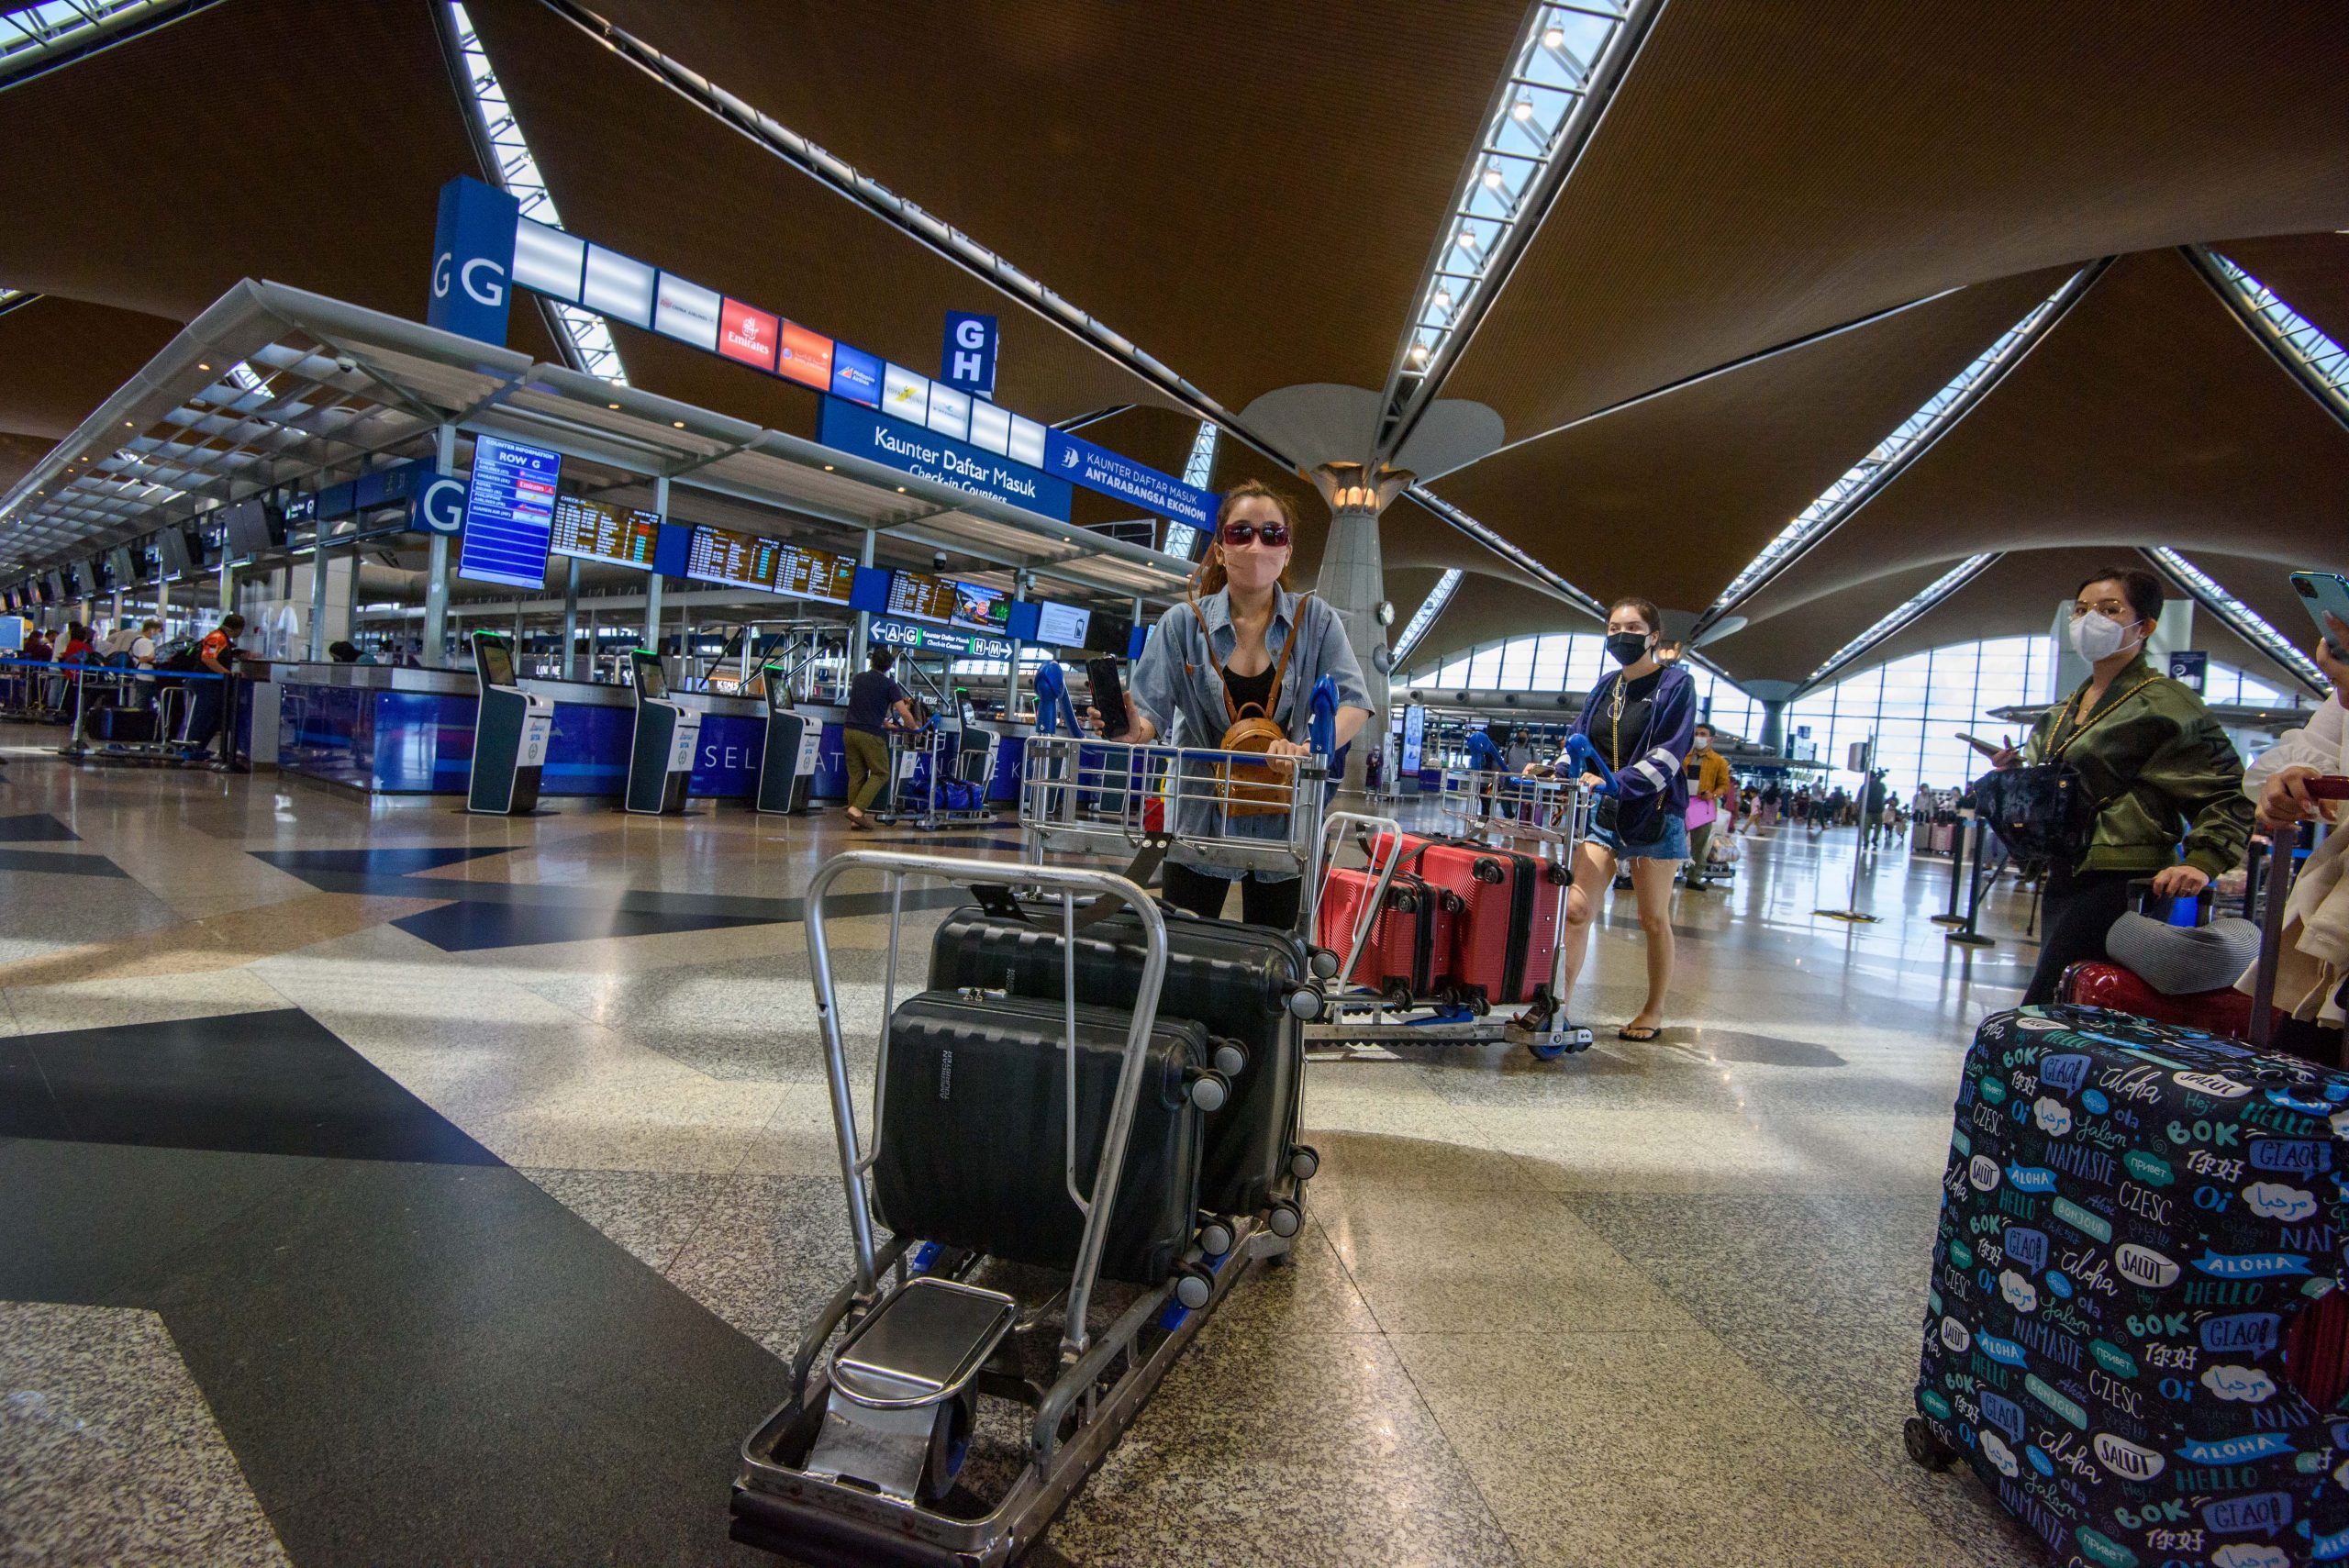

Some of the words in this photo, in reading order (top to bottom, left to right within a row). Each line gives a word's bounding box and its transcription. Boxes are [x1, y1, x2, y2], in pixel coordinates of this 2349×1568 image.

[434, 252, 451, 298] G
[462, 258, 504, 306] G
[728, 330, 769, 355] Emirates
[956, 320, 985, 349] G
[953, 350, 982, 382] H
[485, 439, 514, 450] COUNTER
[514, 446, 554, 460] INFORMATION
[499, 451, 528, 465] ROW
[532, 460, 540, 469] G
[874, 426, 940, 464] Kaunter
[943, 450, 990, 482] Daftar
[993, 467, 1036, 498] Masuk
[1087, 452, 1131, 479] KAUNTER
[1133, 471, 1168, 493] DAFTAR
[1169, 485, 1197, 505] MASUK
[424, 480, 465, 531] G
[561, 495, 586, 505] CHECK-IN
[1085, 467, 1165, 506] ANTARABANGSA
[1167, 498, 1207, 522] EKONOMI
[922, 630, 941, 639] Kaunter
[927, 639, 946, 648] Check-in
[2002, 1046, 2039, 1069] BOK
[940, 1050, 948, 1099] AMERICAN
[944, 1051, 952, 1100] TOURISTER
[2011, 1070, 2039, 1096] 你好
[2099, 1065, 2163, 1105] Aloha
[2180, 1075, 2236, 1095] SALUT
[1973, 1102, 2004, 1137] CZESC
[2011, 1099, 2032, 1126] Oi
[2114, 1108, 2140, 1130] ola
[2239, 1100, 2315, 1137] HELLO
[2166, 1119, 2240, 1147] BOK
[1973, 1160, 1998, 1187] SALUT
[2044, 1140, 2117, 1187] NAMASTE
[2131, 1157, 2167, 1178] привет
[2187, 1149, 2245, 1184] 你好
[2011, 1173, 2050, 1185] ALOHA
[1998, 1187, 2036, 1220] HELLO
[2119, 1181, 2173, 1227] CZESC
[2192, 1184, 2235, 1215] Oi
[2258, 1186, 2308, 1217] مرحبا
[1970, 1214, 2001, 1235] BOK
[2057, 1204, 2105, 1235] BONJOUR
[1977, 1238, 2004, 1268] 你好
[2121, 1250, 2173, 1284] SALUT
[2208, 1256, 2293, 1273] ALOHA
[1944, 1264, 1971, 1302] CZESC
[1977, 1268, 1998, 1296] Oi
[2061, 1247, 2119, 1296] Aloha
[2076, 1296, 2101, 1319] ola
[2183, 1281, 2264, 1307] HELLO
[1943, 1321, 1967, 1349] SALUT
[2125, 1310, 2189, 1338] BOK
[2210, 1318, 2270, 1351] CIAO!
[1981, 1338, 2020, 1359] ALOHA
[2012, 1316, 2085, 1374] NAMASTE
[2097, 1346, 2132, 1371] привет
[2145, 1342, 2198, 1371] 你好
[1944, 1373, 1975, 1395] BOK
[1971, 1351, 2009, 1391] HELLO
[2214, 1370, 2266, 1397] مرحبا
[2031, 1381, 2078, 1419] BONJOUR
[2089, 1369, 2145, 1419] CZESC
[2158, 1377, 2197, 1404] Oi
[1954, 1395, 1980, 1425] 你好
[2039, 1423, 2102, 1485] Aloha
[2102, 1440, 2156, 1475] SALUT
[2191, 1437, 2276, 1461] ALOHA
[2175, 1466, 2258, 1492] HELLO
[2113, 1497, 2191, 1530] BOK
[2082, 1533, 2127, 1563] привет
[2143, 1527, 2206, 1553] 你好
